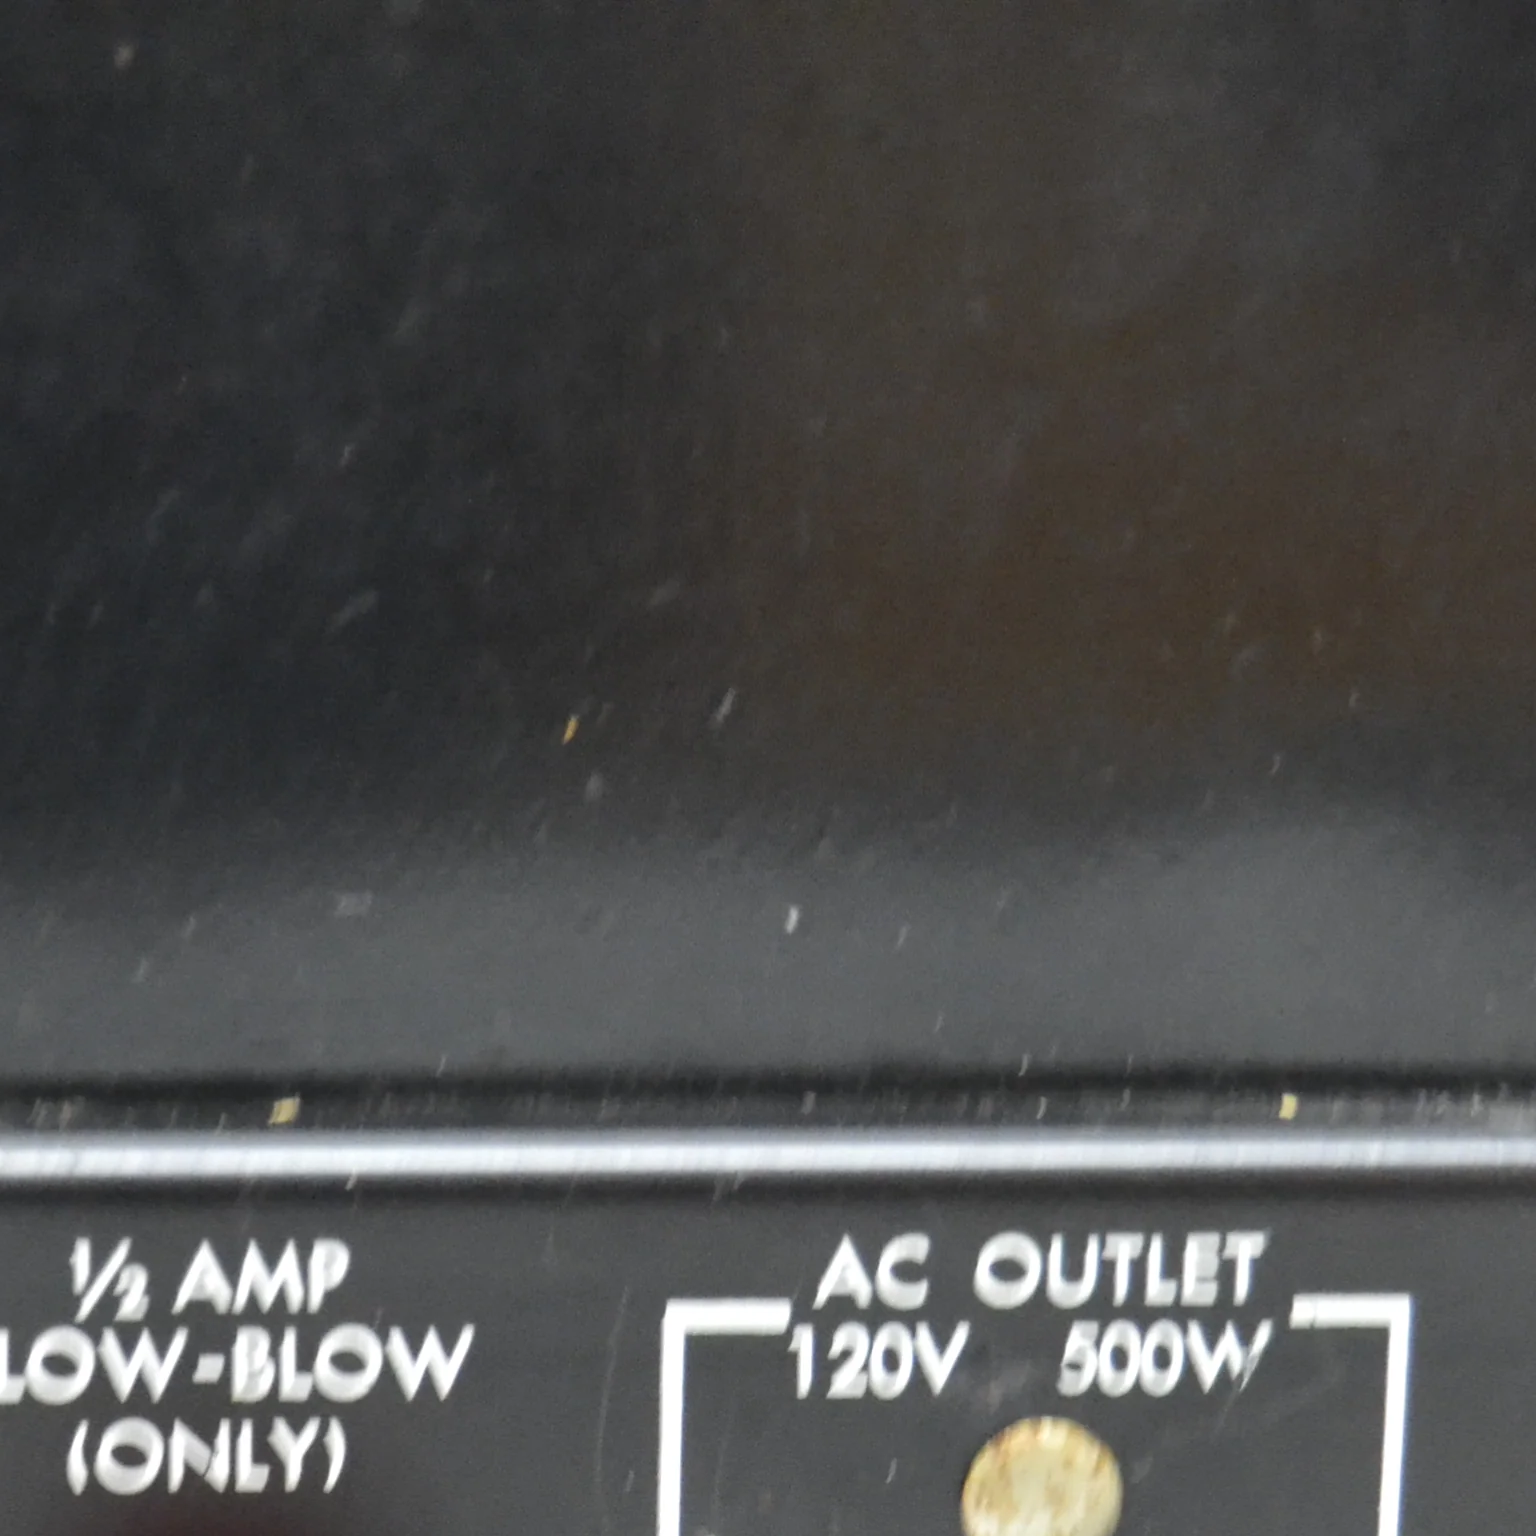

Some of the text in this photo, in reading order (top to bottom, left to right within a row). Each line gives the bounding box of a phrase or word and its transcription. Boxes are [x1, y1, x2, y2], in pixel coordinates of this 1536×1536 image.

[172, 1238, 350, 1314] AMP
[813, 1231, 1268, 1309] AC OUTLET
[788, 1318, 1272, 1399] 120V 500W
[66, 1416, 347, 1495] (ONLY)
